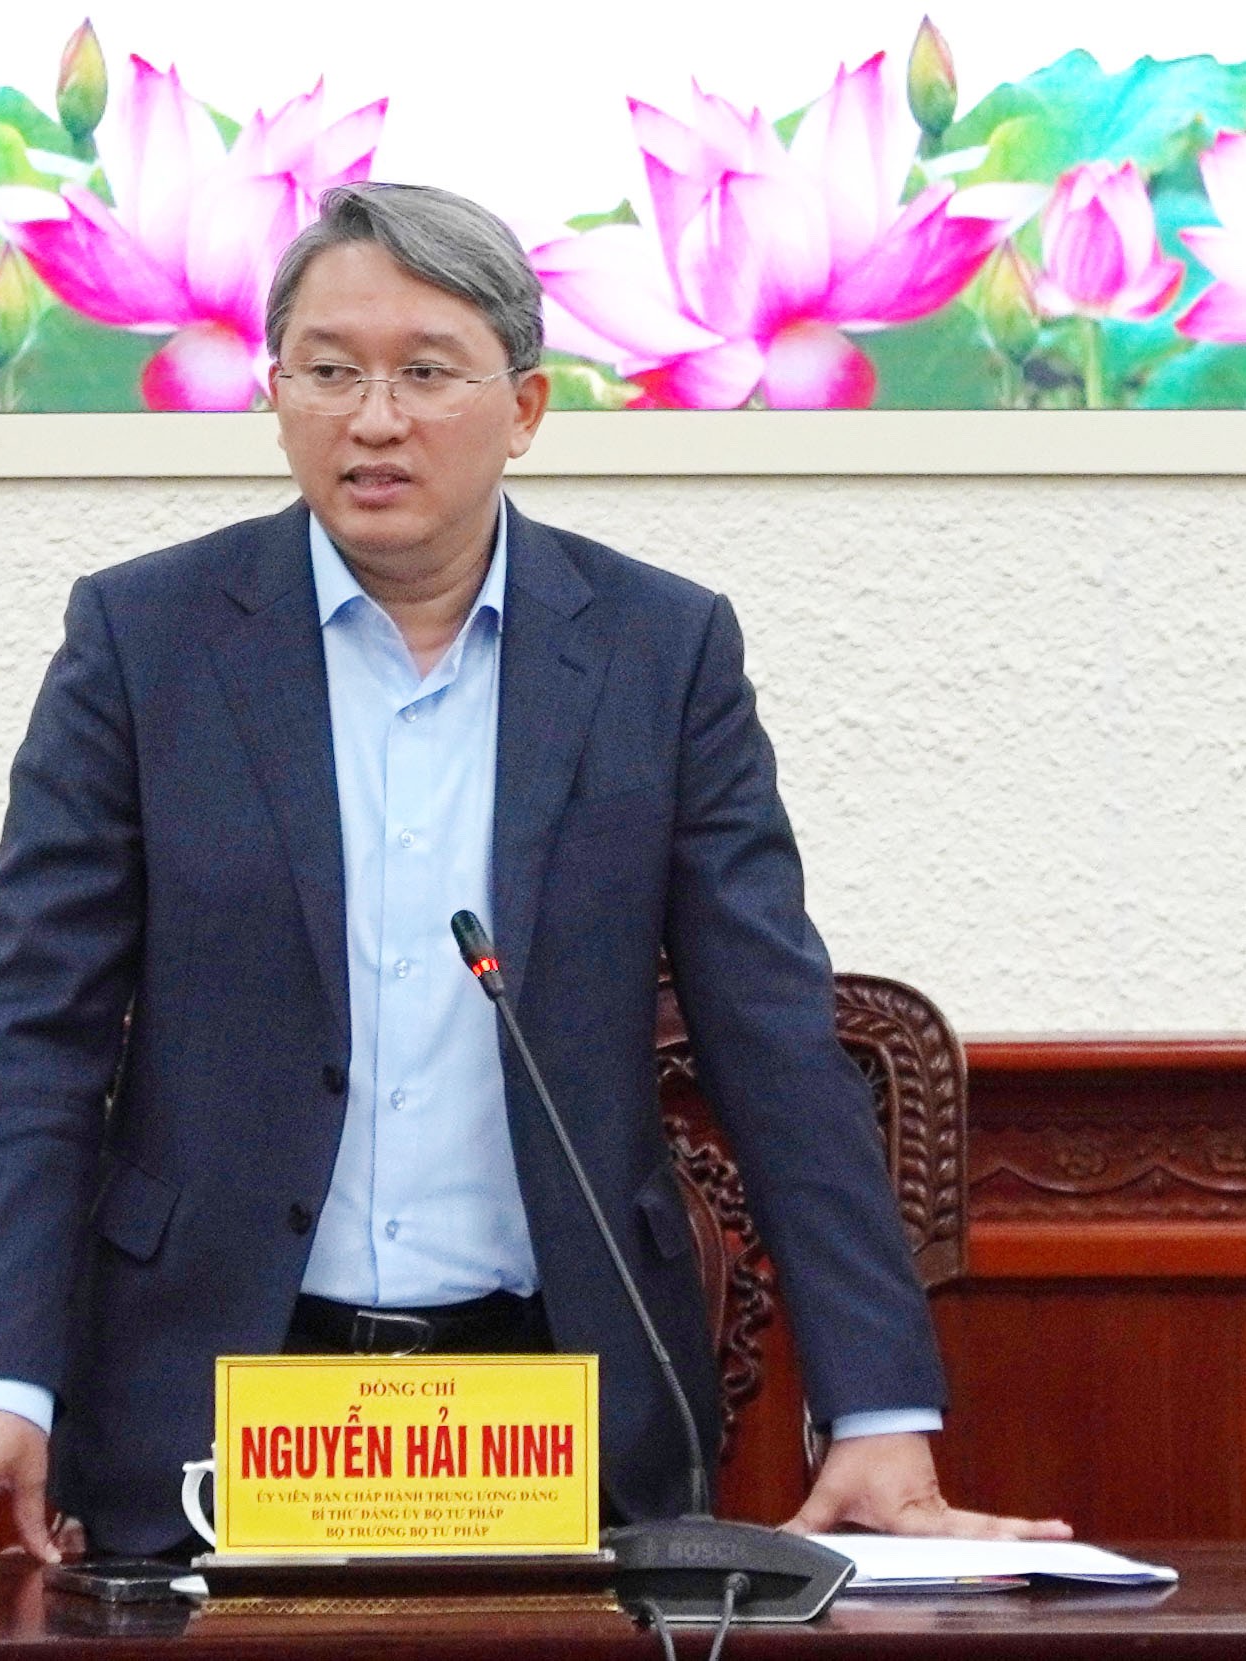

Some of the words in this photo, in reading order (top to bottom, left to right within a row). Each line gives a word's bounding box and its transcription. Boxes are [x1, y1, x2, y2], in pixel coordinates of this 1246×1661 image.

[360, 1378, 415, 1397] ĐỒNG
[421, 1377, 456, 1396] CHÍ
[241, 1405, 393, 1480] NGUYỄN
[406, 1406, 468, 1478] HẢI
[481, 1424, 574, 1478] NINH
[313, 1491, 342, 1503] BAN
[427, 1491, 473, 1503] TRUNG
[477, 1489, 517, 1503] ƯƠNG
[311, 1506, 325, 1521] BÍ
[468, 1505, 504, 1520] PHÁP
[326, 1526, 345, 1540] BỘ
[410, 1526, 429, 1540] BỘ
[454, 1523, 490, 1537] PHÁP
